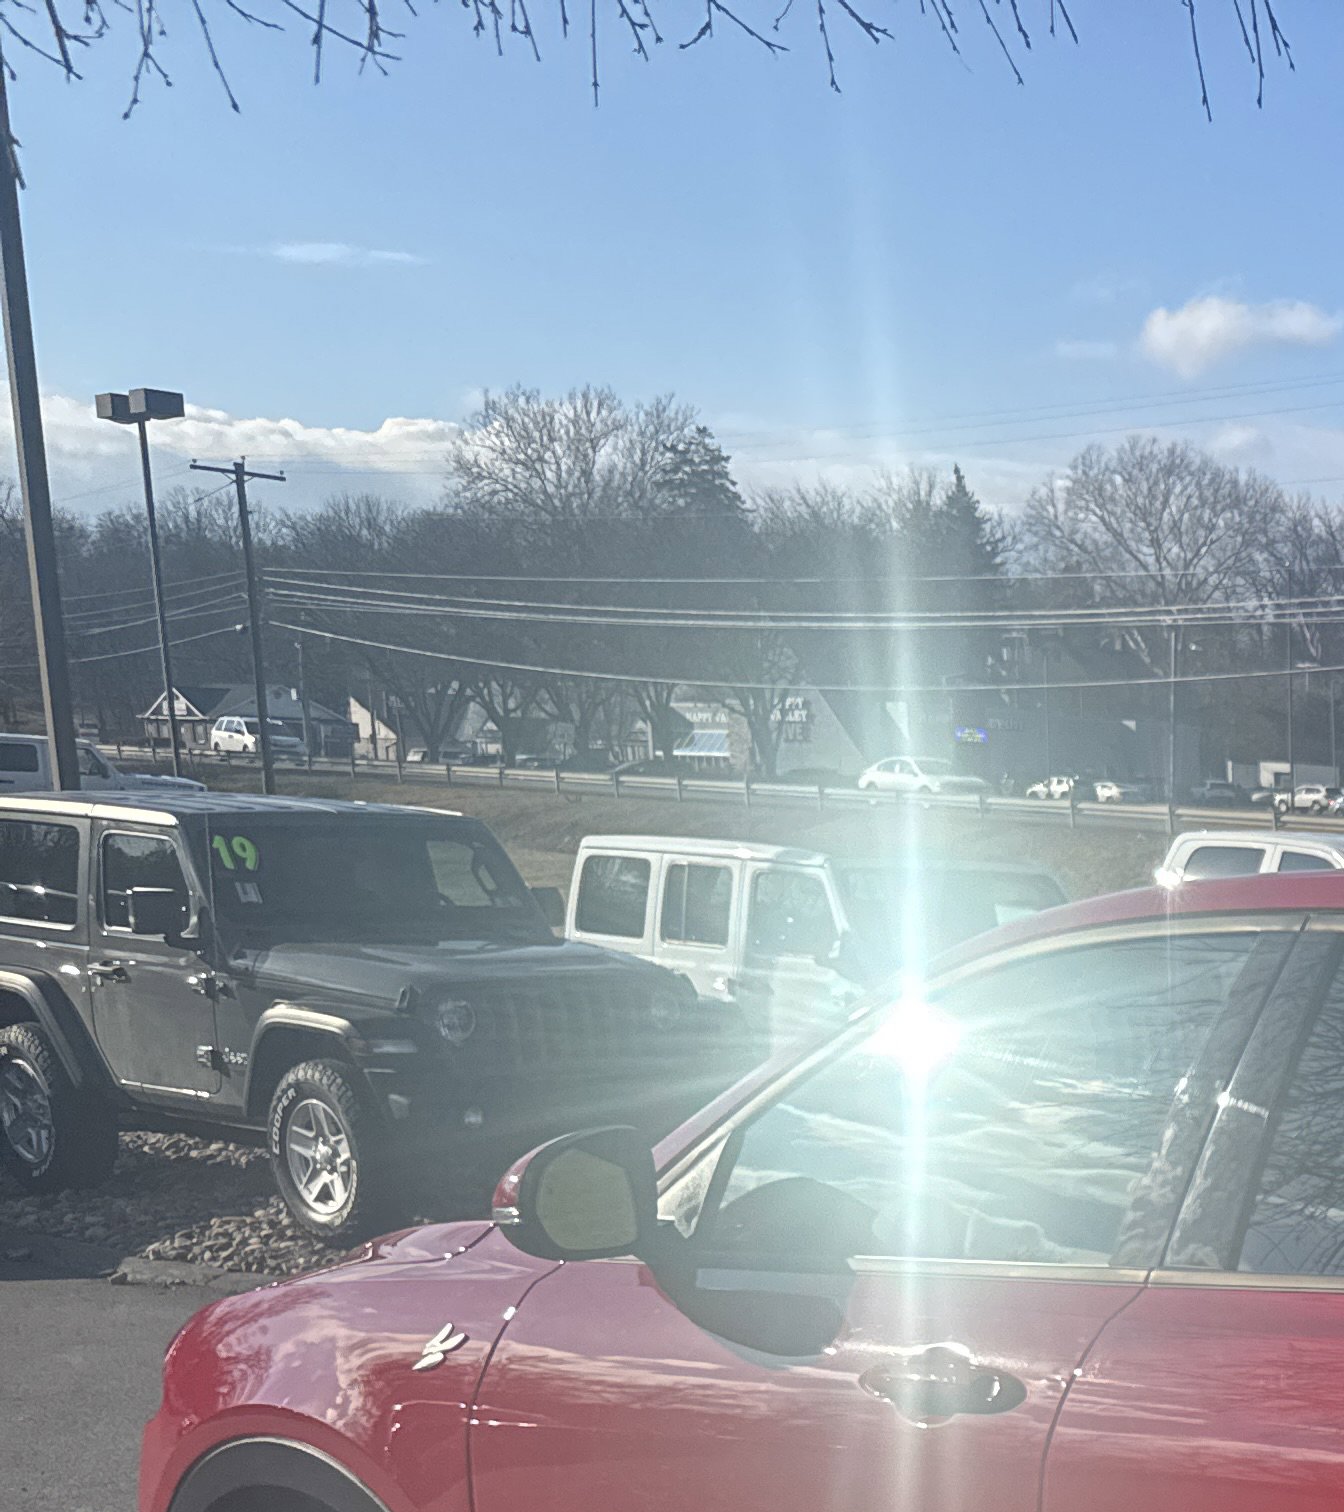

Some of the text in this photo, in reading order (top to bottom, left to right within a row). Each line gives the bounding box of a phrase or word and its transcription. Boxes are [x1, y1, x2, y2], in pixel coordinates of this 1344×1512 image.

[770, 709, 808, 722] VALEY
[212, 834, 258, 871] 19
[272, 1087, 297, 1155] COOPER
